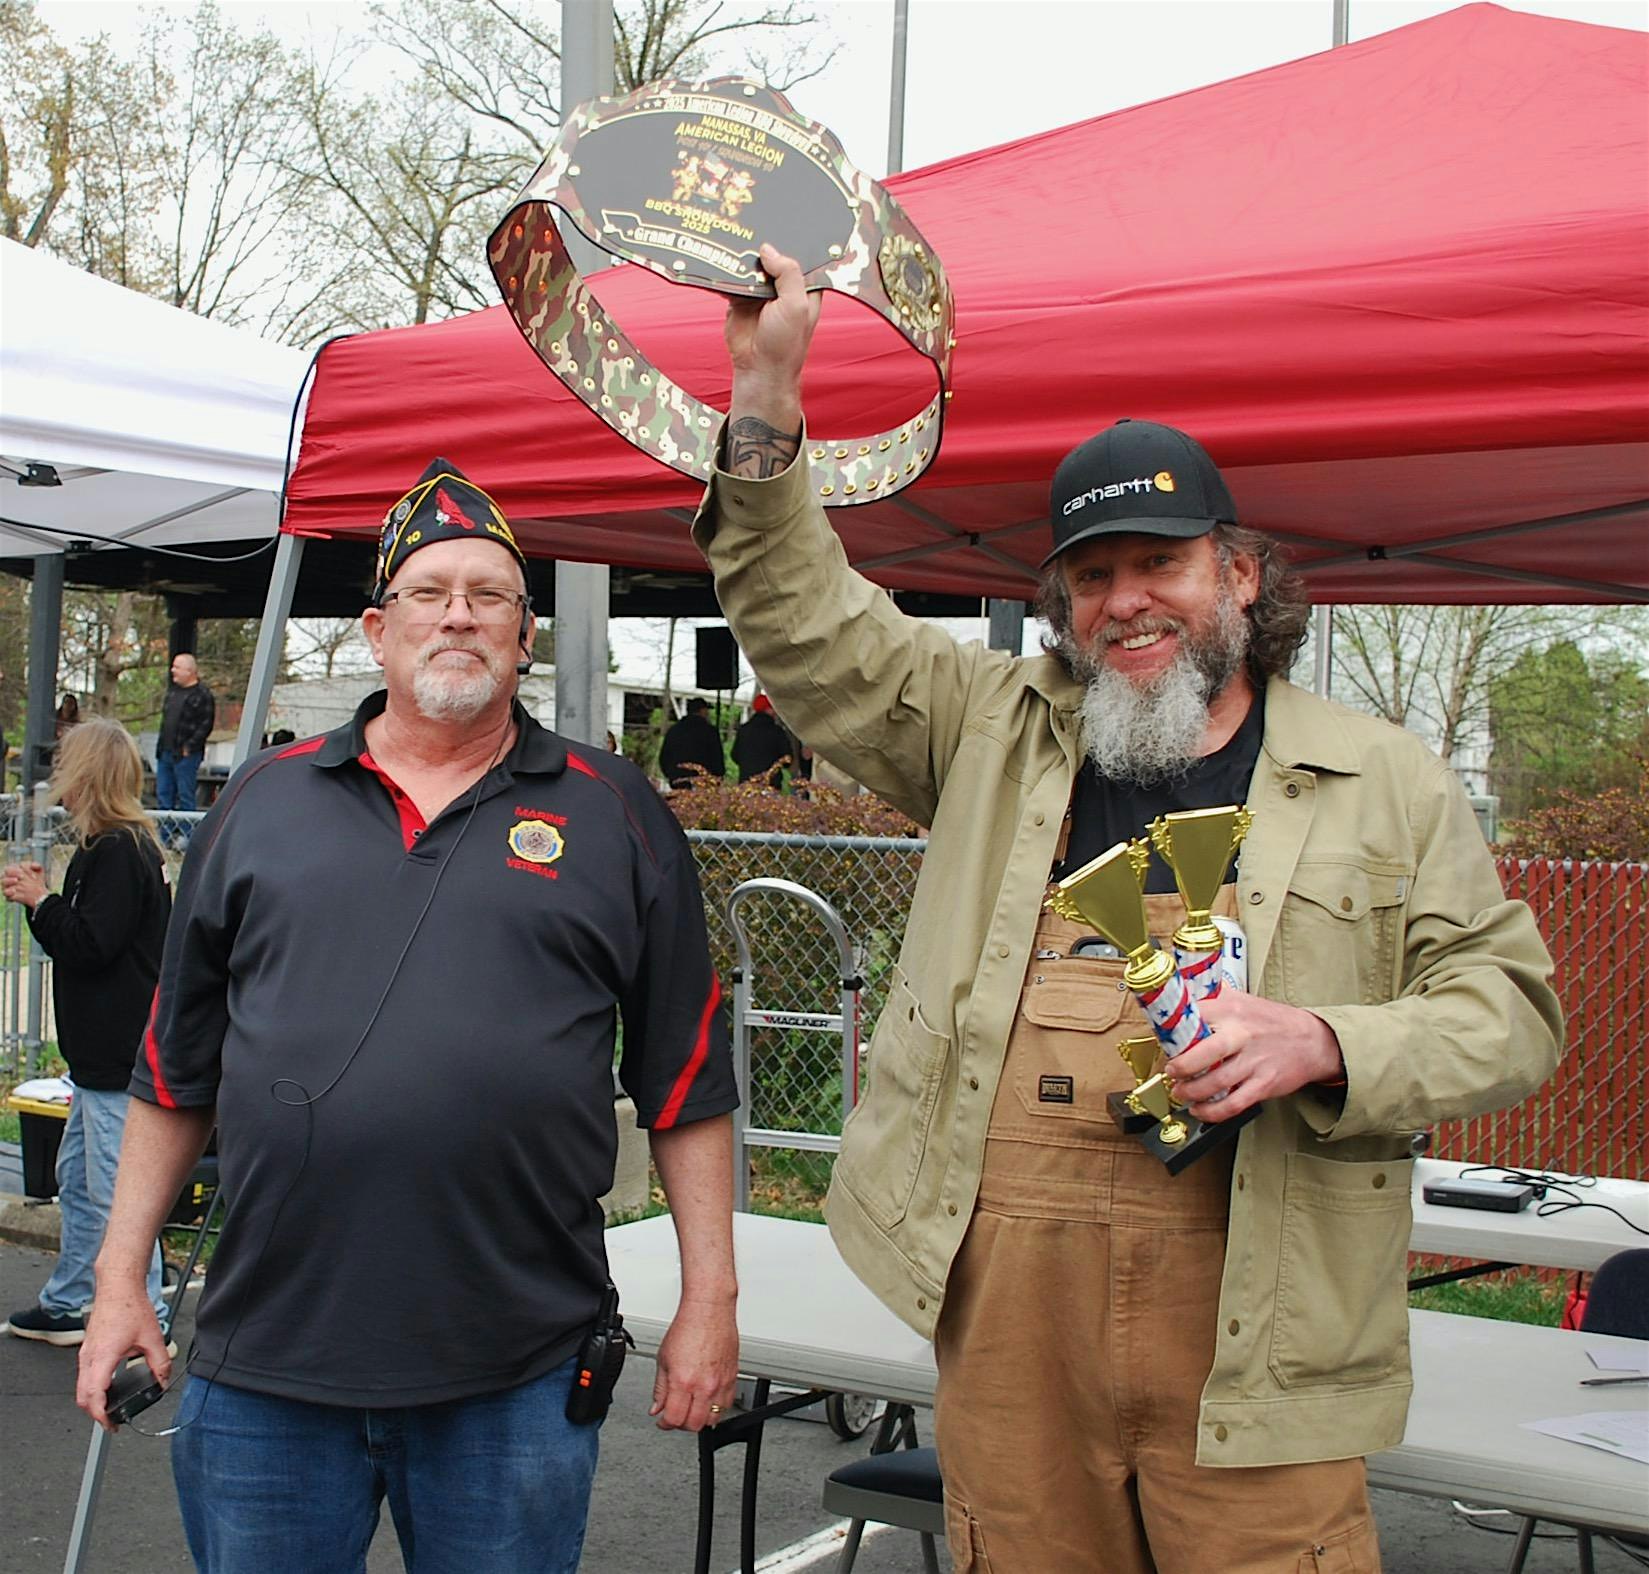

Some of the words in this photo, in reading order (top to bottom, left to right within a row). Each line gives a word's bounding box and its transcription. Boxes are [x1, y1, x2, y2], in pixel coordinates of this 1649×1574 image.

[675, 121, 738, 147] AMERICAN
[740, 140, 784, 168] LEGION
[701, 115, 751, 140] MANASSAS,
[754, 130, 768, 145] VA
[645, 198, 673, 216] BBQ
[674, 205, 754, 241] SHOWDOWN
[681, 218, 711, 235] 2025
[634, 226, 676, 247] Grand
[677, 235, 741, 272] Champion
[1062, 477, 1154, 516] carhartt
[514, 806, 568, 827] MARINE
[506, 857, 558, 880] VETERAN
[769, 1015, 830, 1028] MAGLINER
